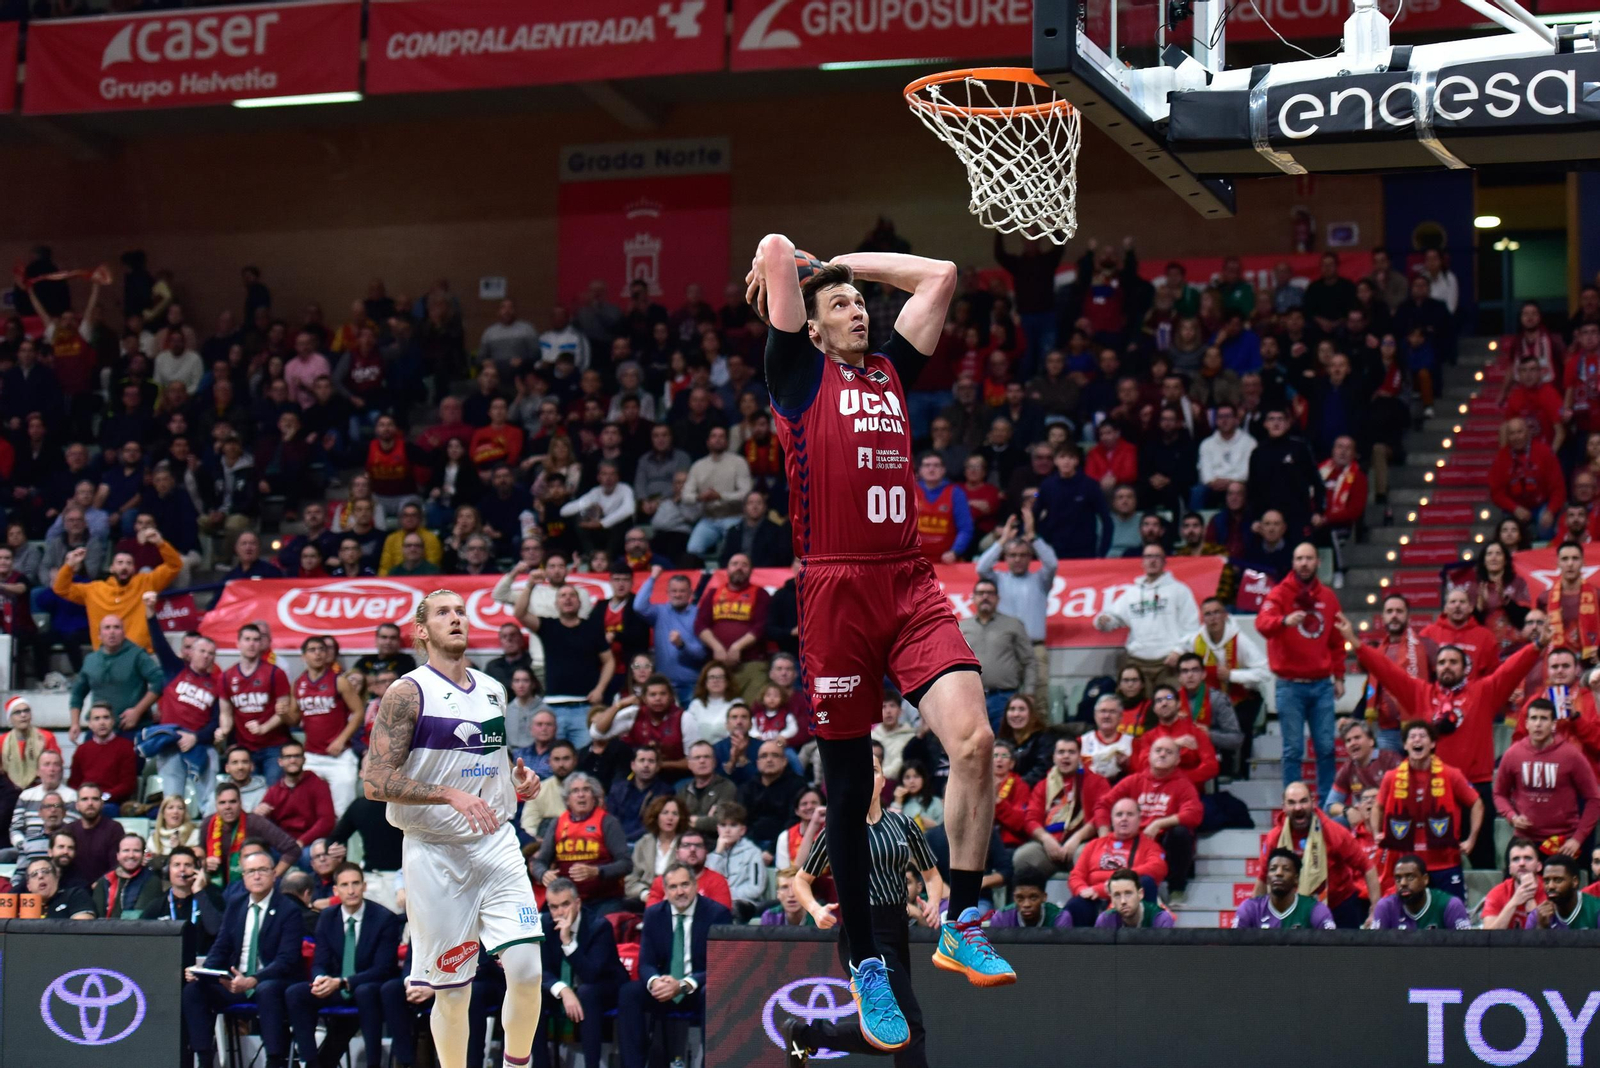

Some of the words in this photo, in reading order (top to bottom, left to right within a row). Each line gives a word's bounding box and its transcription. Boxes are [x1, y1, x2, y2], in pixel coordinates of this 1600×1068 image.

[801, 0, 1033, 35] GRUPOSURE
[136, 12, 280, 62] caser
[386, 16, 656, 59] COMPRALAENTRADA
[100, 77, 174, 102] Grupo
[181, 67, 278, 95] Helvetia
[1278, 69, 1576, 139] endesa
[568, 151, 645, 172] Grada
[655, 146, 722, 168] Norte
[867, 485, 907, 523] 00
[292, 593, 407, 619] Juver
[175, 681, 215, 708] UCAM
[814, 675, 861, 693] ESP
[479, 731, 504, 744] Unica
[555, 839, 600, 853] UCAM
[1408, 988, 1600, 1067] TOY
